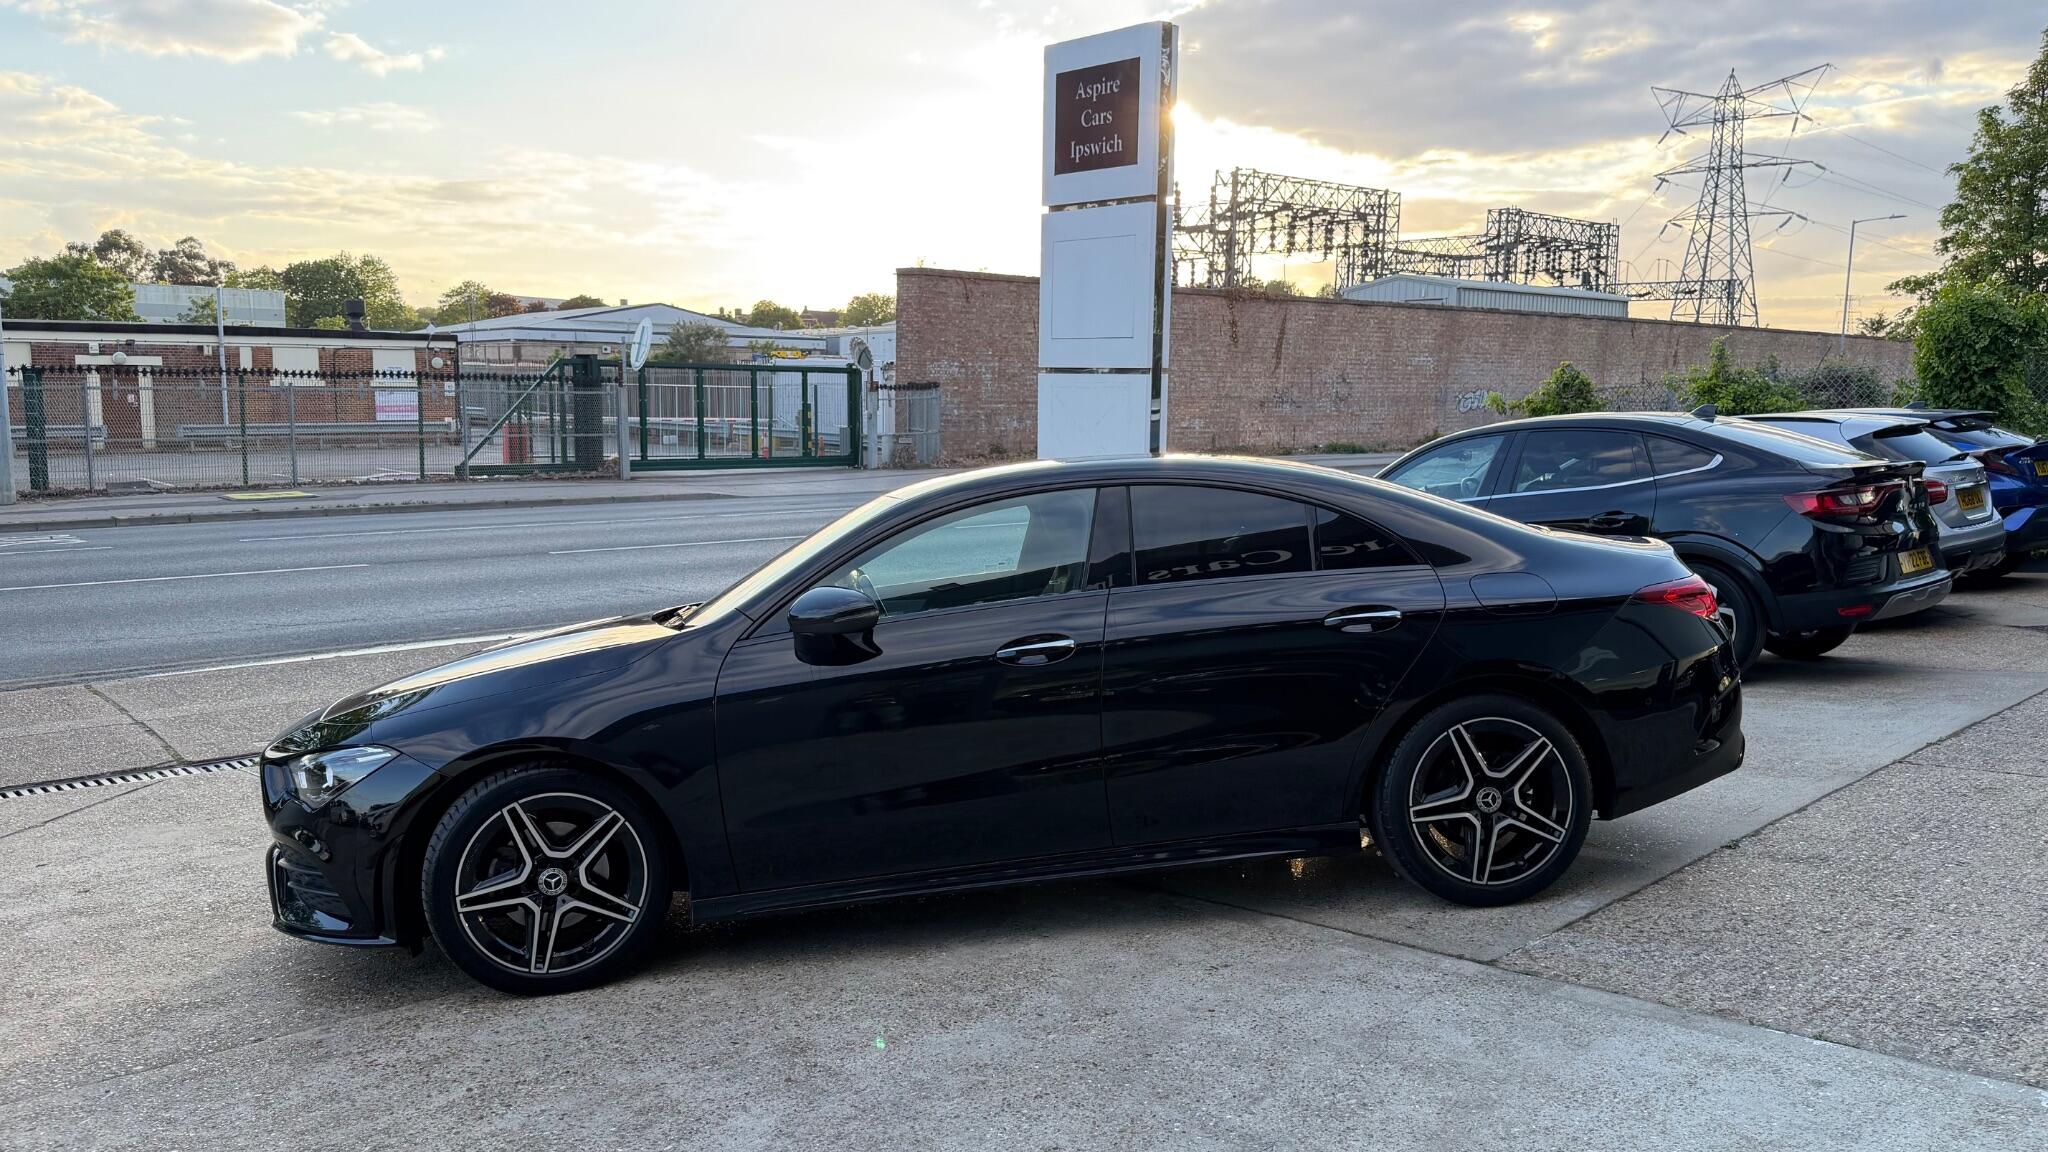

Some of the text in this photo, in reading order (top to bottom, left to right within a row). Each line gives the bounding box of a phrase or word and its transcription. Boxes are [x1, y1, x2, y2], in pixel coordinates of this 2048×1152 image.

[1076, 77, 1121, 101] Aspire
[1081, 109, 1113, 128] Cars
[1070, 134, 1123, 163] Ipswich
